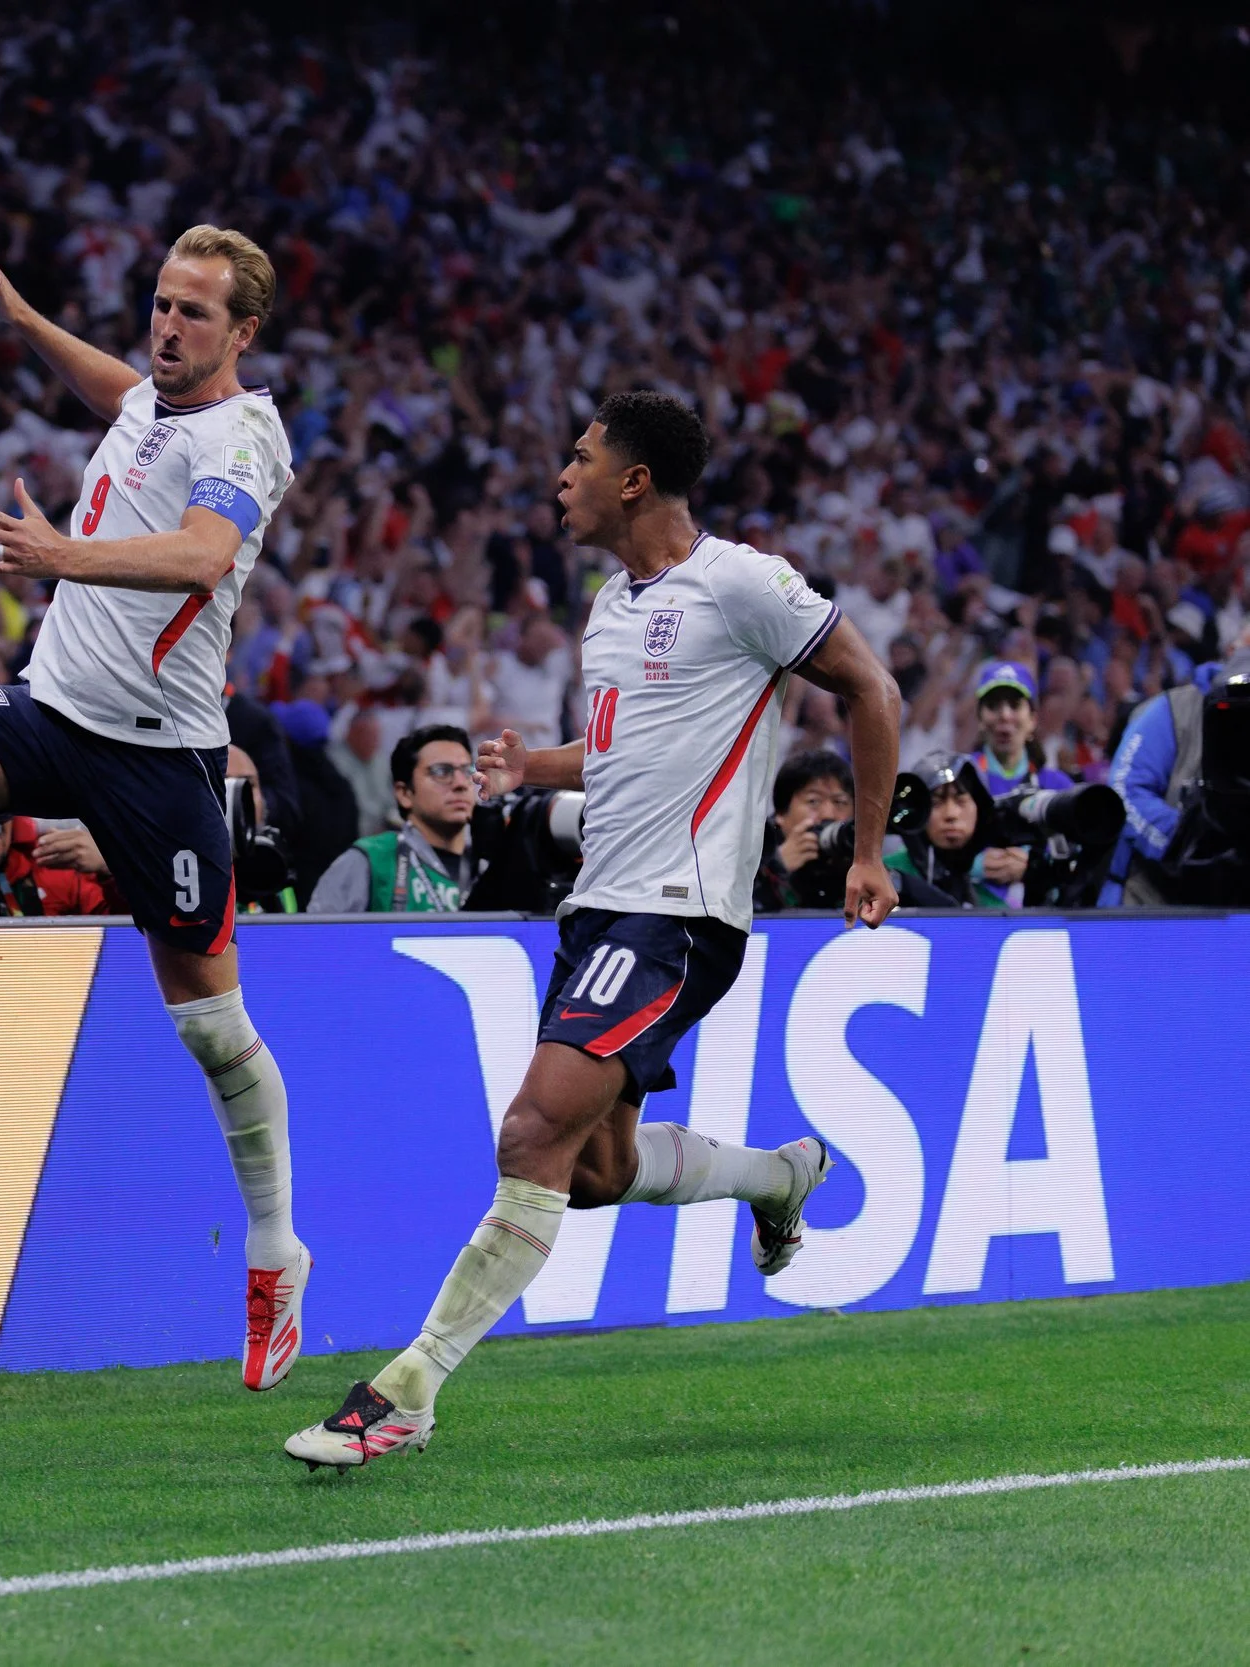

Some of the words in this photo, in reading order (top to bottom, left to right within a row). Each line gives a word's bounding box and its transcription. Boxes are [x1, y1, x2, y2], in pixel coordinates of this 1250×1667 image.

[82, 474, 111, 536] 9
[194, 485, 236, 500] UNITES
[198, 480, 238, 494] FOOTBALL
[204, 493, 235, 508] World
[644, 661, 668, 670] MEXICO
[586, 687, 619, 755] 10
[172, 850, 200, 913] 9
[571, 944, 637, 1006] 10
[392, 926, 1115, 1325] VISA
